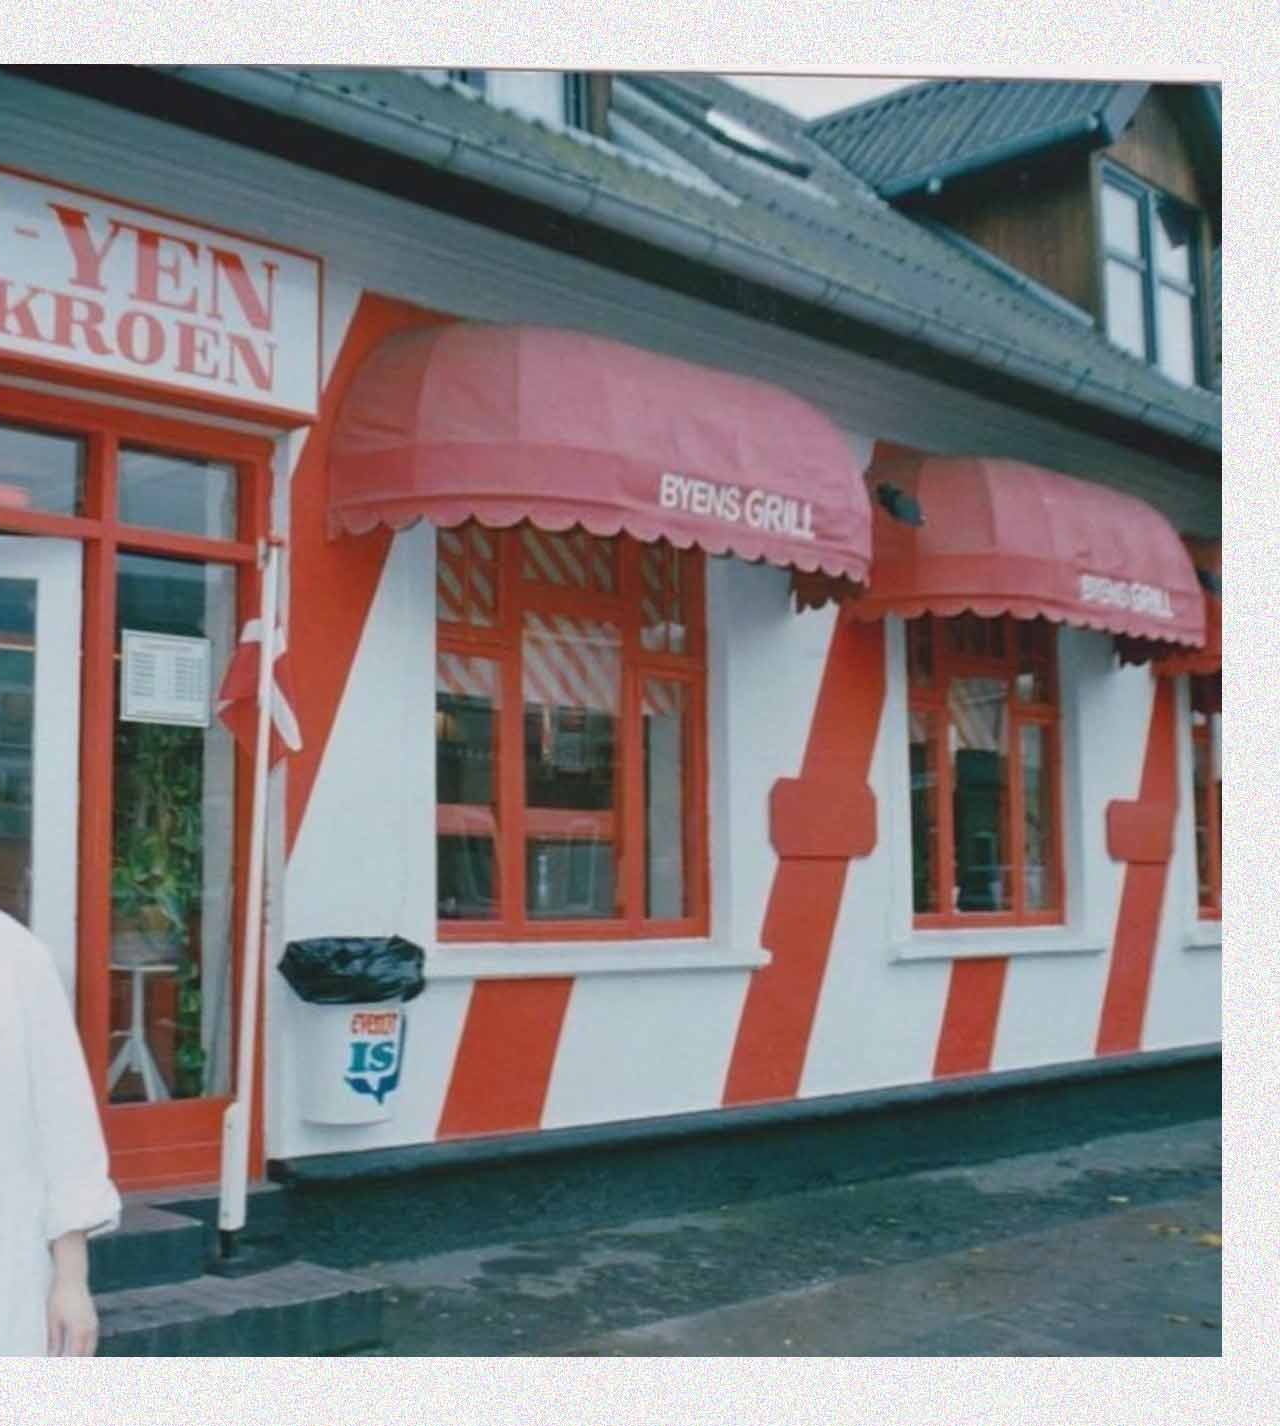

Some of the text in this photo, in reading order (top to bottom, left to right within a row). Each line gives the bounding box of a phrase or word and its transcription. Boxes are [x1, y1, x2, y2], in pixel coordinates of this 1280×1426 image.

[660, 473, 815, 541] BYENS GRILL
[347, 1041, 395, 1074] IS
